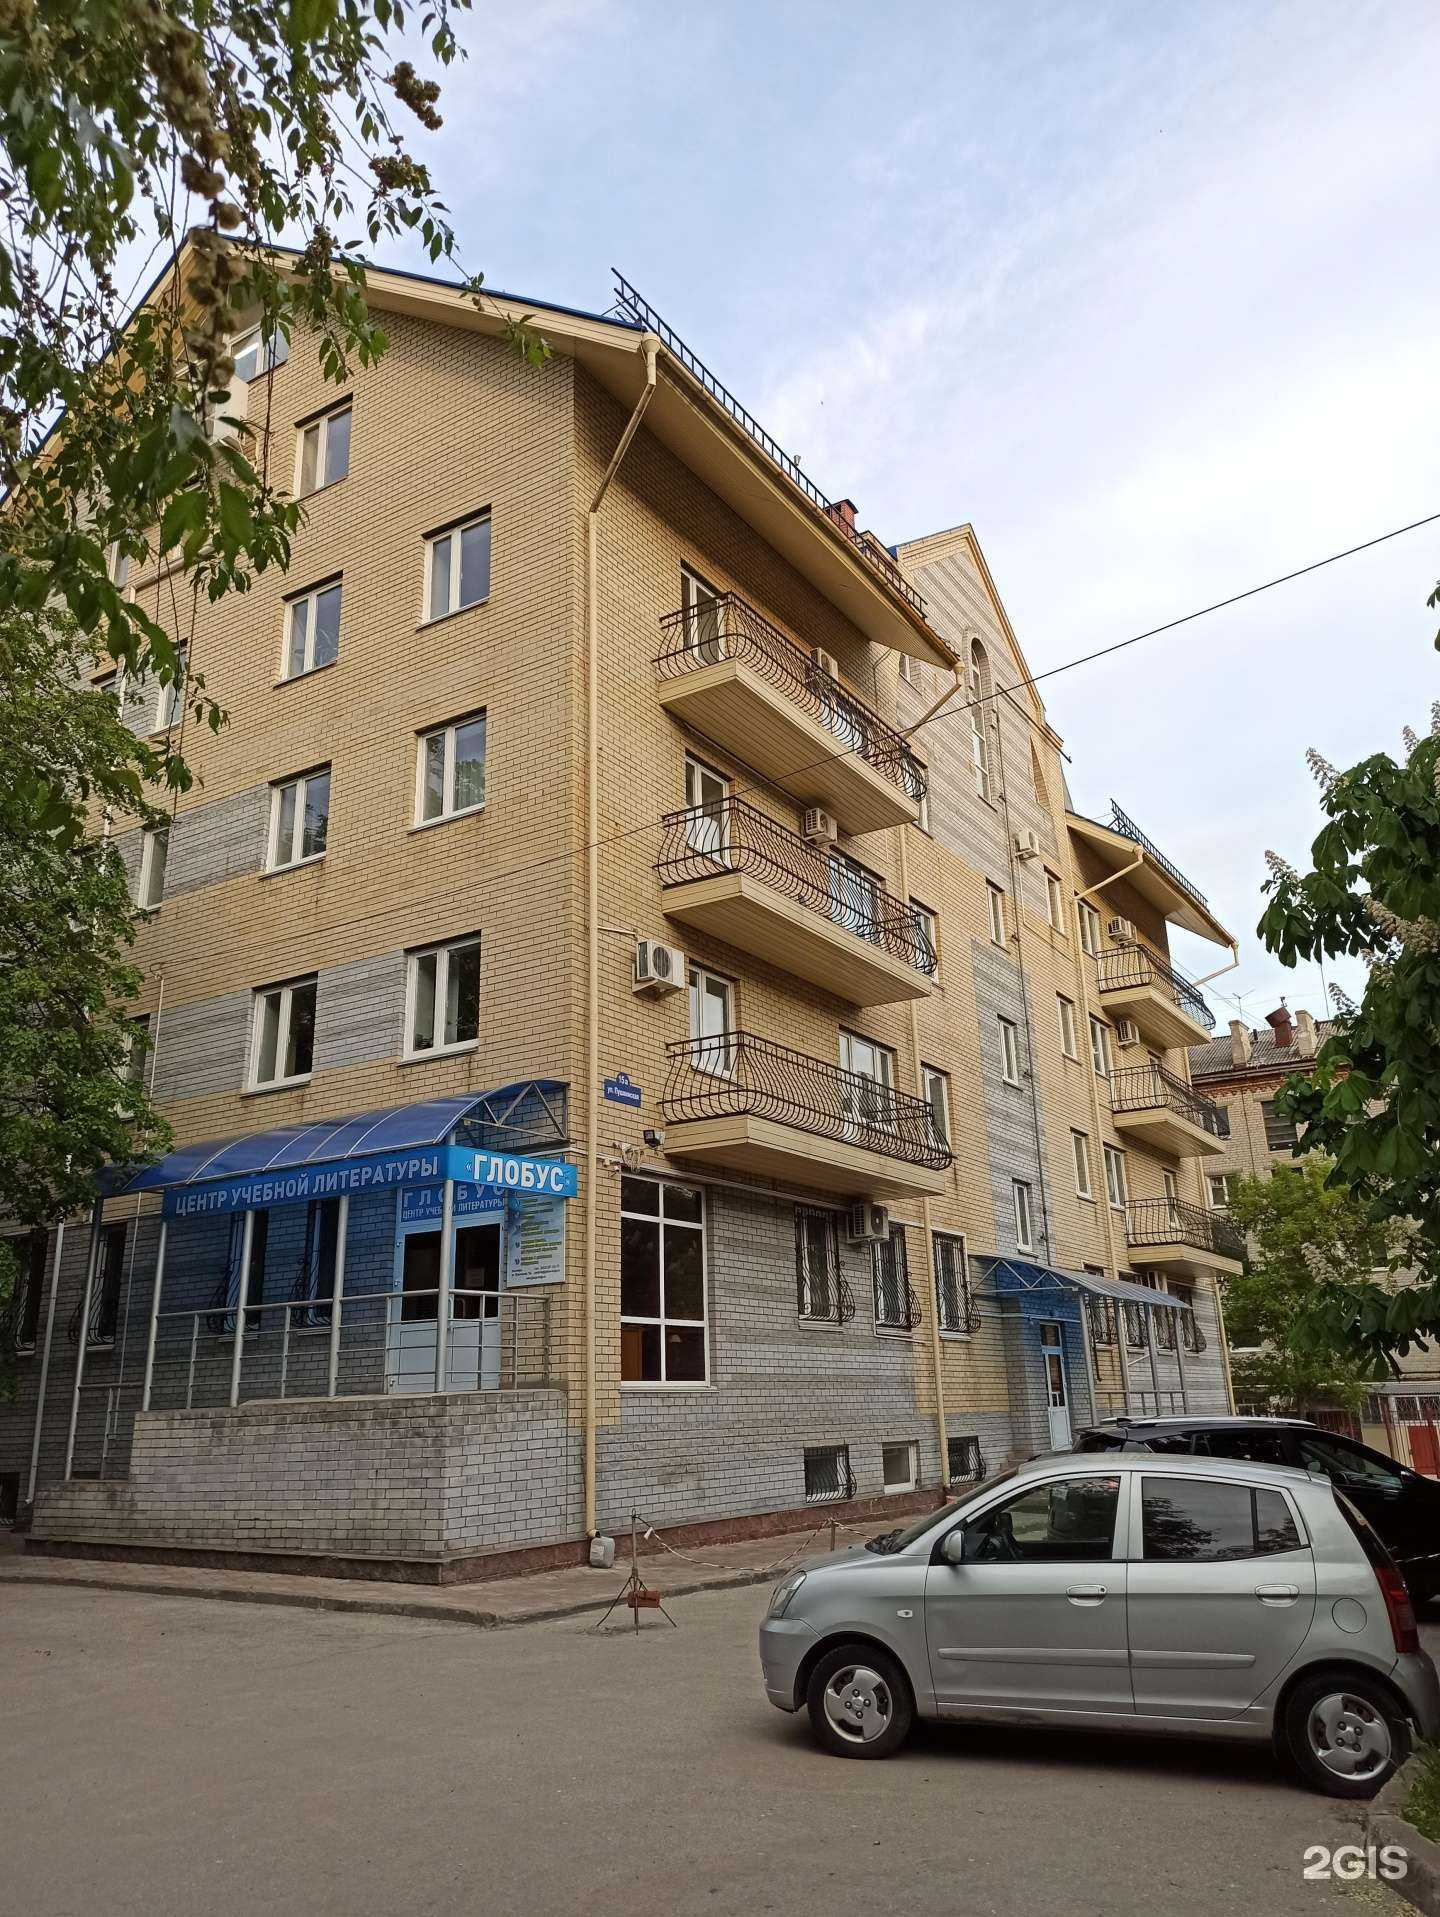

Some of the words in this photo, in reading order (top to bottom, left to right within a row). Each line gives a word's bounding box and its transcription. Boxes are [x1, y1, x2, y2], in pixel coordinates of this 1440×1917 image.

[175, 1190, 228, 1217] ЦЕНТР
[231, 1173, 309, 1206] УЧЕБНОЙ
[312, 1156, 438, 1194] ЛИТЕРАТУРЫ
[402, 1208, 424, 1220] ЦЕНТР
[458, 1198, 505, 1212] ЛИТЕРАТУРЫ
